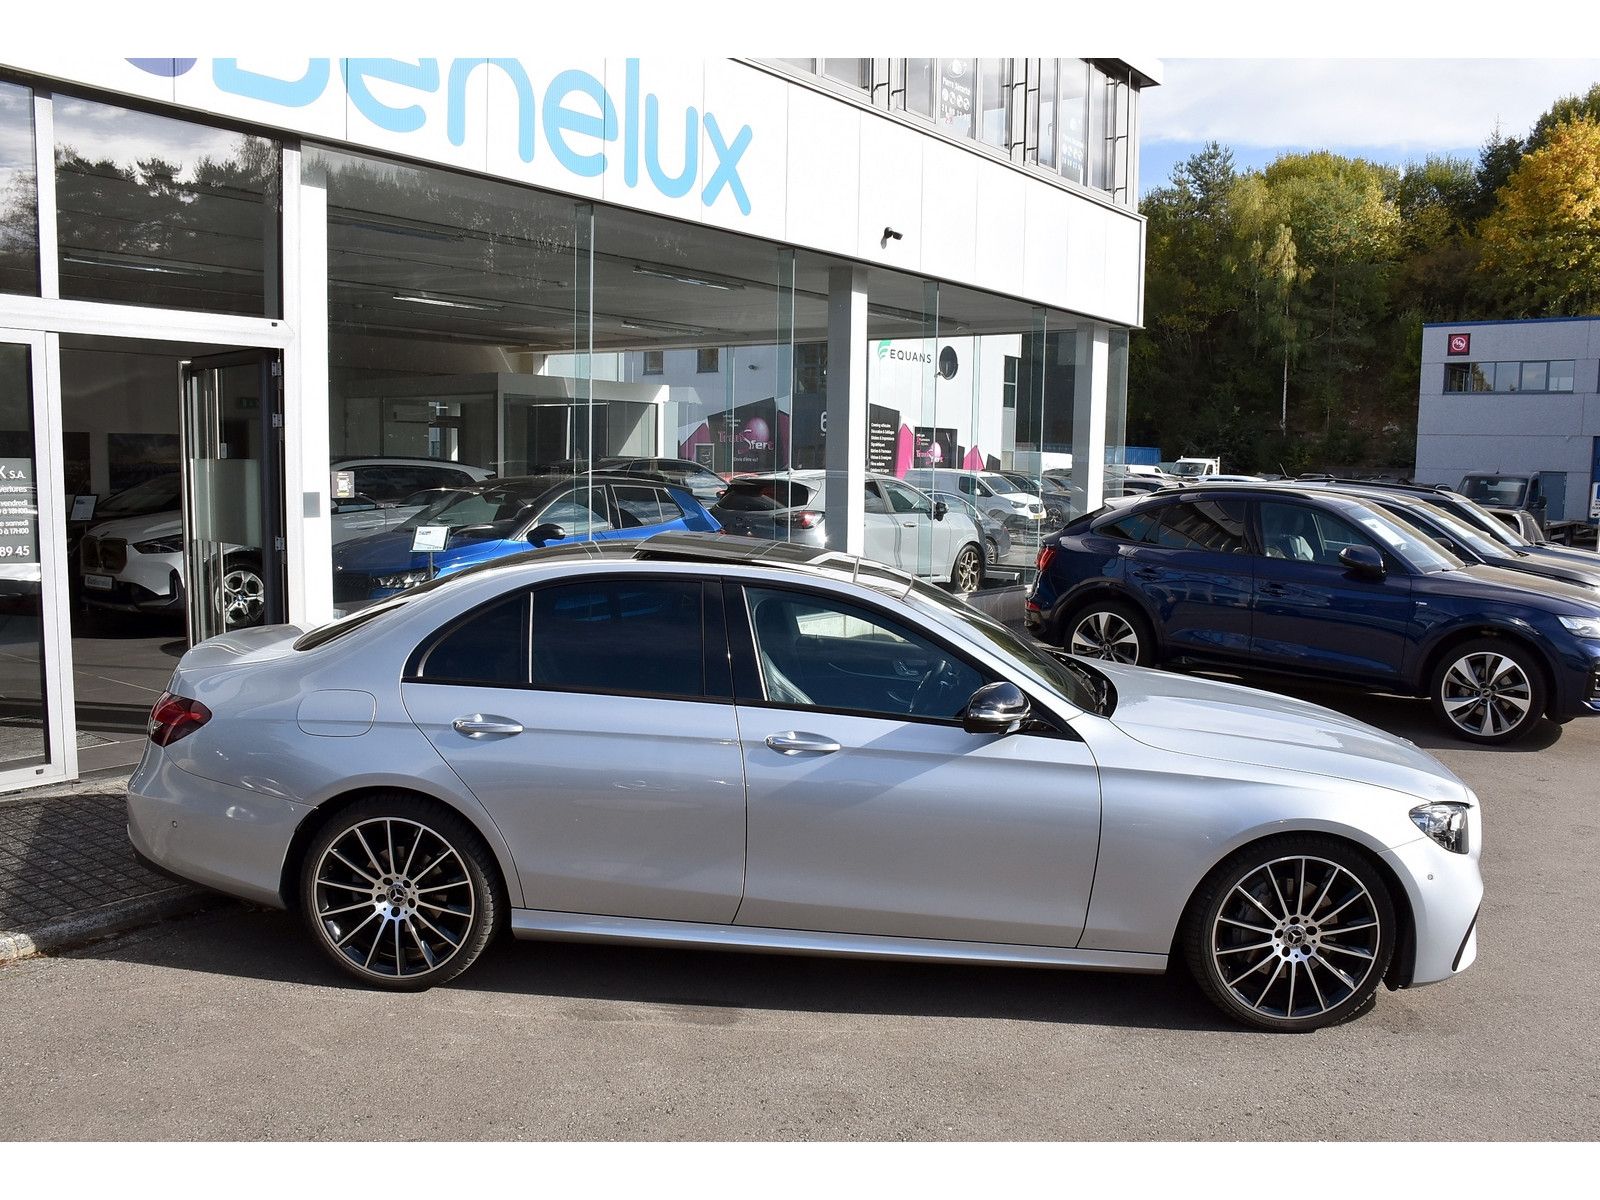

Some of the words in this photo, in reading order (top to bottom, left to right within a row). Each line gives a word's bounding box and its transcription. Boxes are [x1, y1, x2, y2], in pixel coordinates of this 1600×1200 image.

[890, 348, 932, 364] EQUANS
[5, 519, 29, 527] samedi
[15, 545, 30, 556] 45
